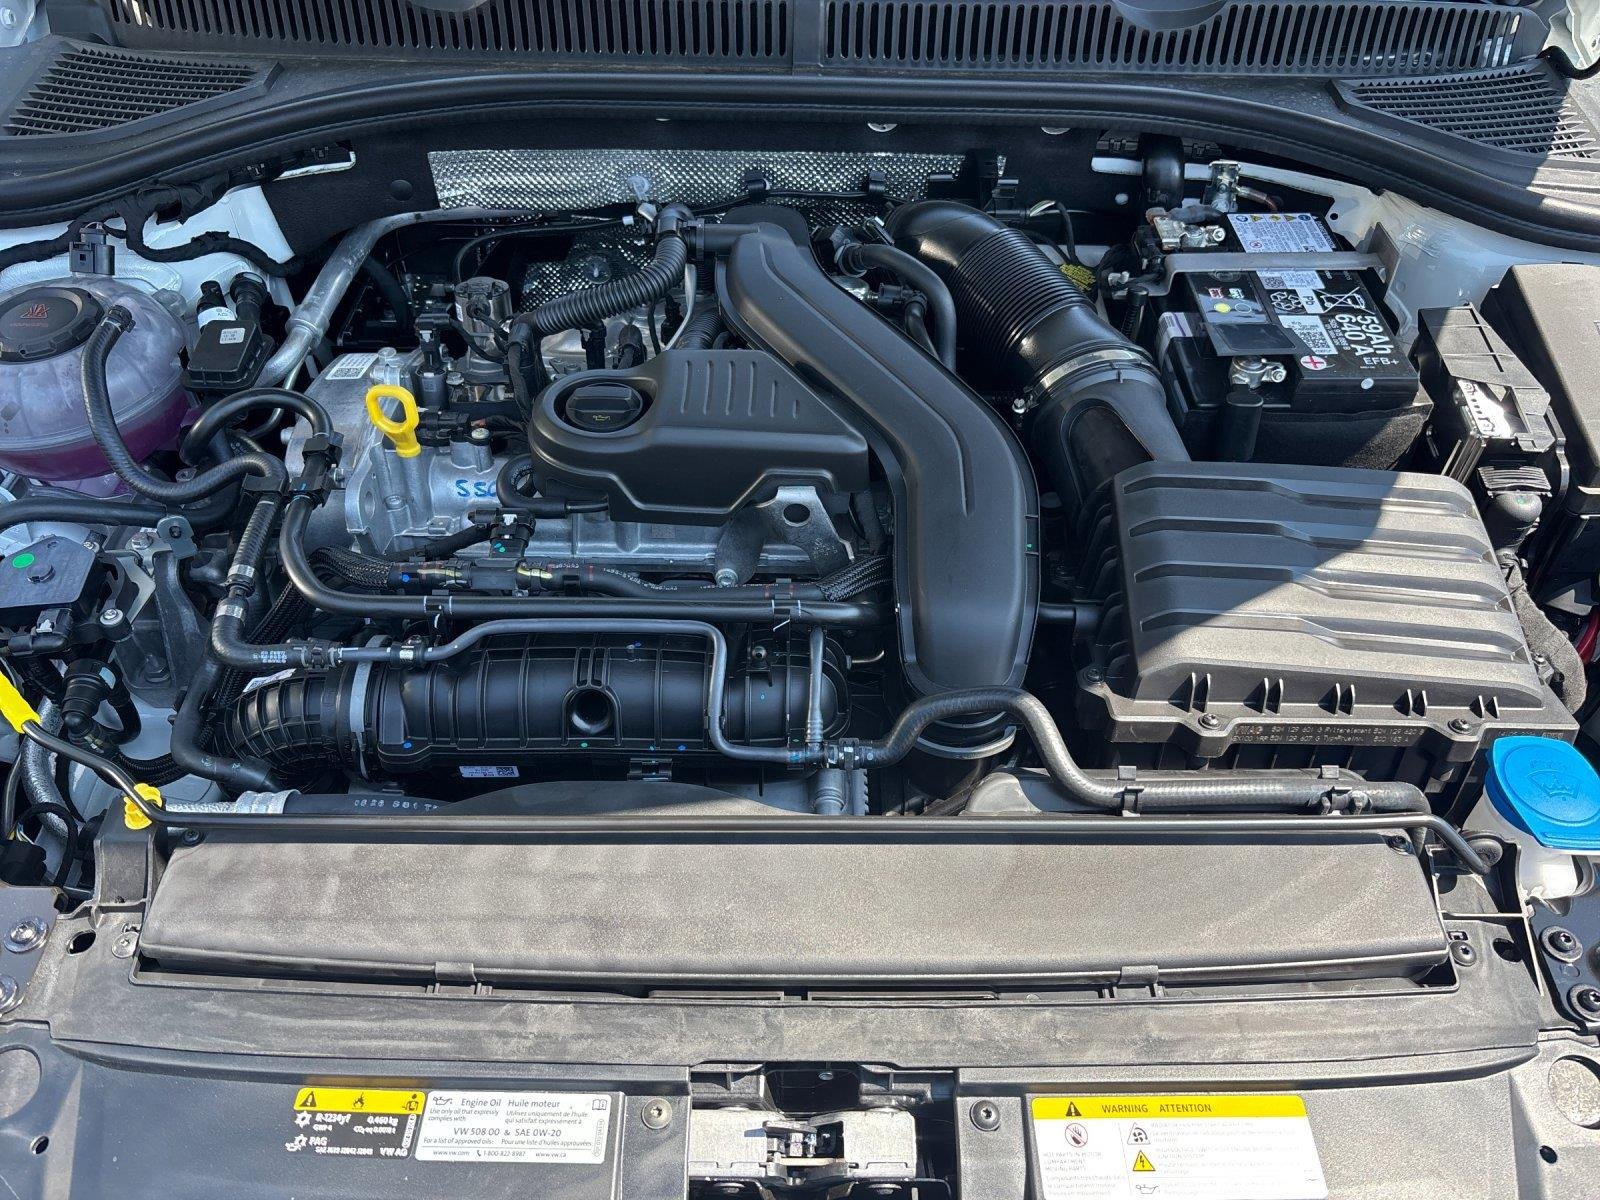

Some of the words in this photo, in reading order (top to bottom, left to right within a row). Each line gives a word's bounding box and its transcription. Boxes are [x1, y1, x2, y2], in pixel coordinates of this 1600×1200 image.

[1303, 295, 1315, 305] Pb
[1335, 314, 1366, 341] 640
[1357, 315, 1394, 354] 59Ah
[1350, 344, 1374, 356] A
[1363, 357, 1399, 365] EFB+
[461, 1099, 488, 1108] Engine
[489, 1098, 502, 1107] Oil
[508, 1099, 529, 1107] Huile
[531, 1100, 560, 1108] moteur
[1101, 1104, 1148, 1113] WARNING
[1160, 1103, 1212, 1113] ATTENTION
[453, 1127, 470, 1136] VW
[470, 1127, 487, 1136] 508
[488, 1128, 500, 1136] 00
[515, 1129, 531, 1137] SAE
[533, 1129, 562, 1137] 0W-20
